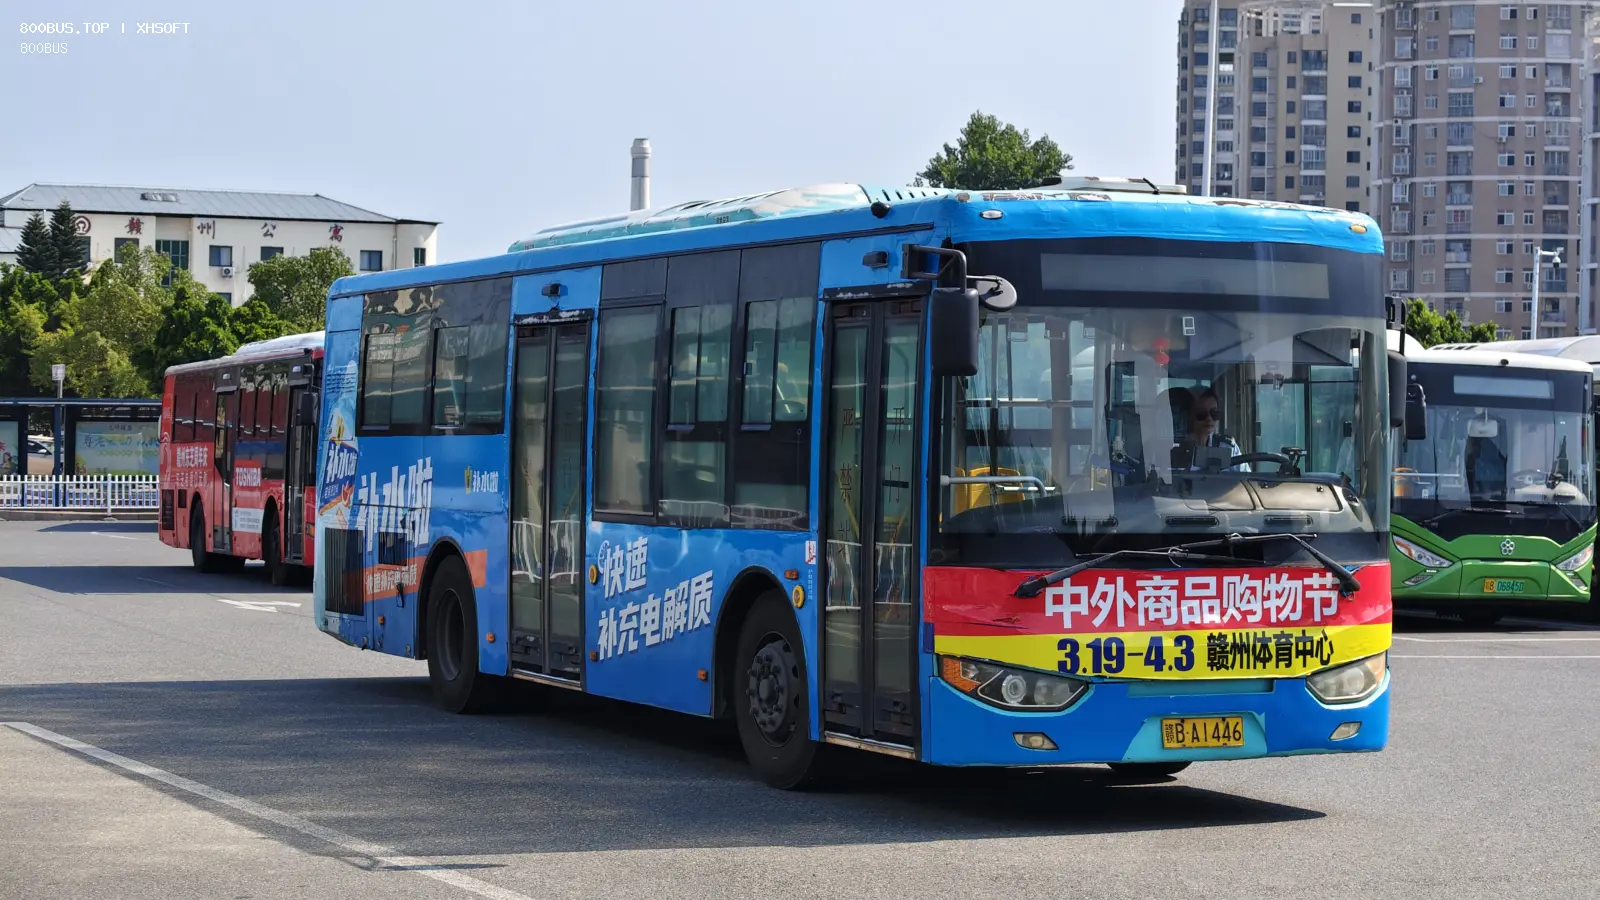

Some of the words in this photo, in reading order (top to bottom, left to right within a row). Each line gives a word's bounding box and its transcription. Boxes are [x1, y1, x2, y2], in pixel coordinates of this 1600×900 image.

[124, 216, 344, 242] 赣州公寓
[356, 456, 433, 552] 补水啦
[472, 470, 499, 493] 补水啦
[602, 536, 649, 598] 快速
[598, 569, 714, 661] 补充电解质
[1045, 572, 1342, 630] 中外商品购物节
[1206, 629, 1334, 672] 赣州体育中心
